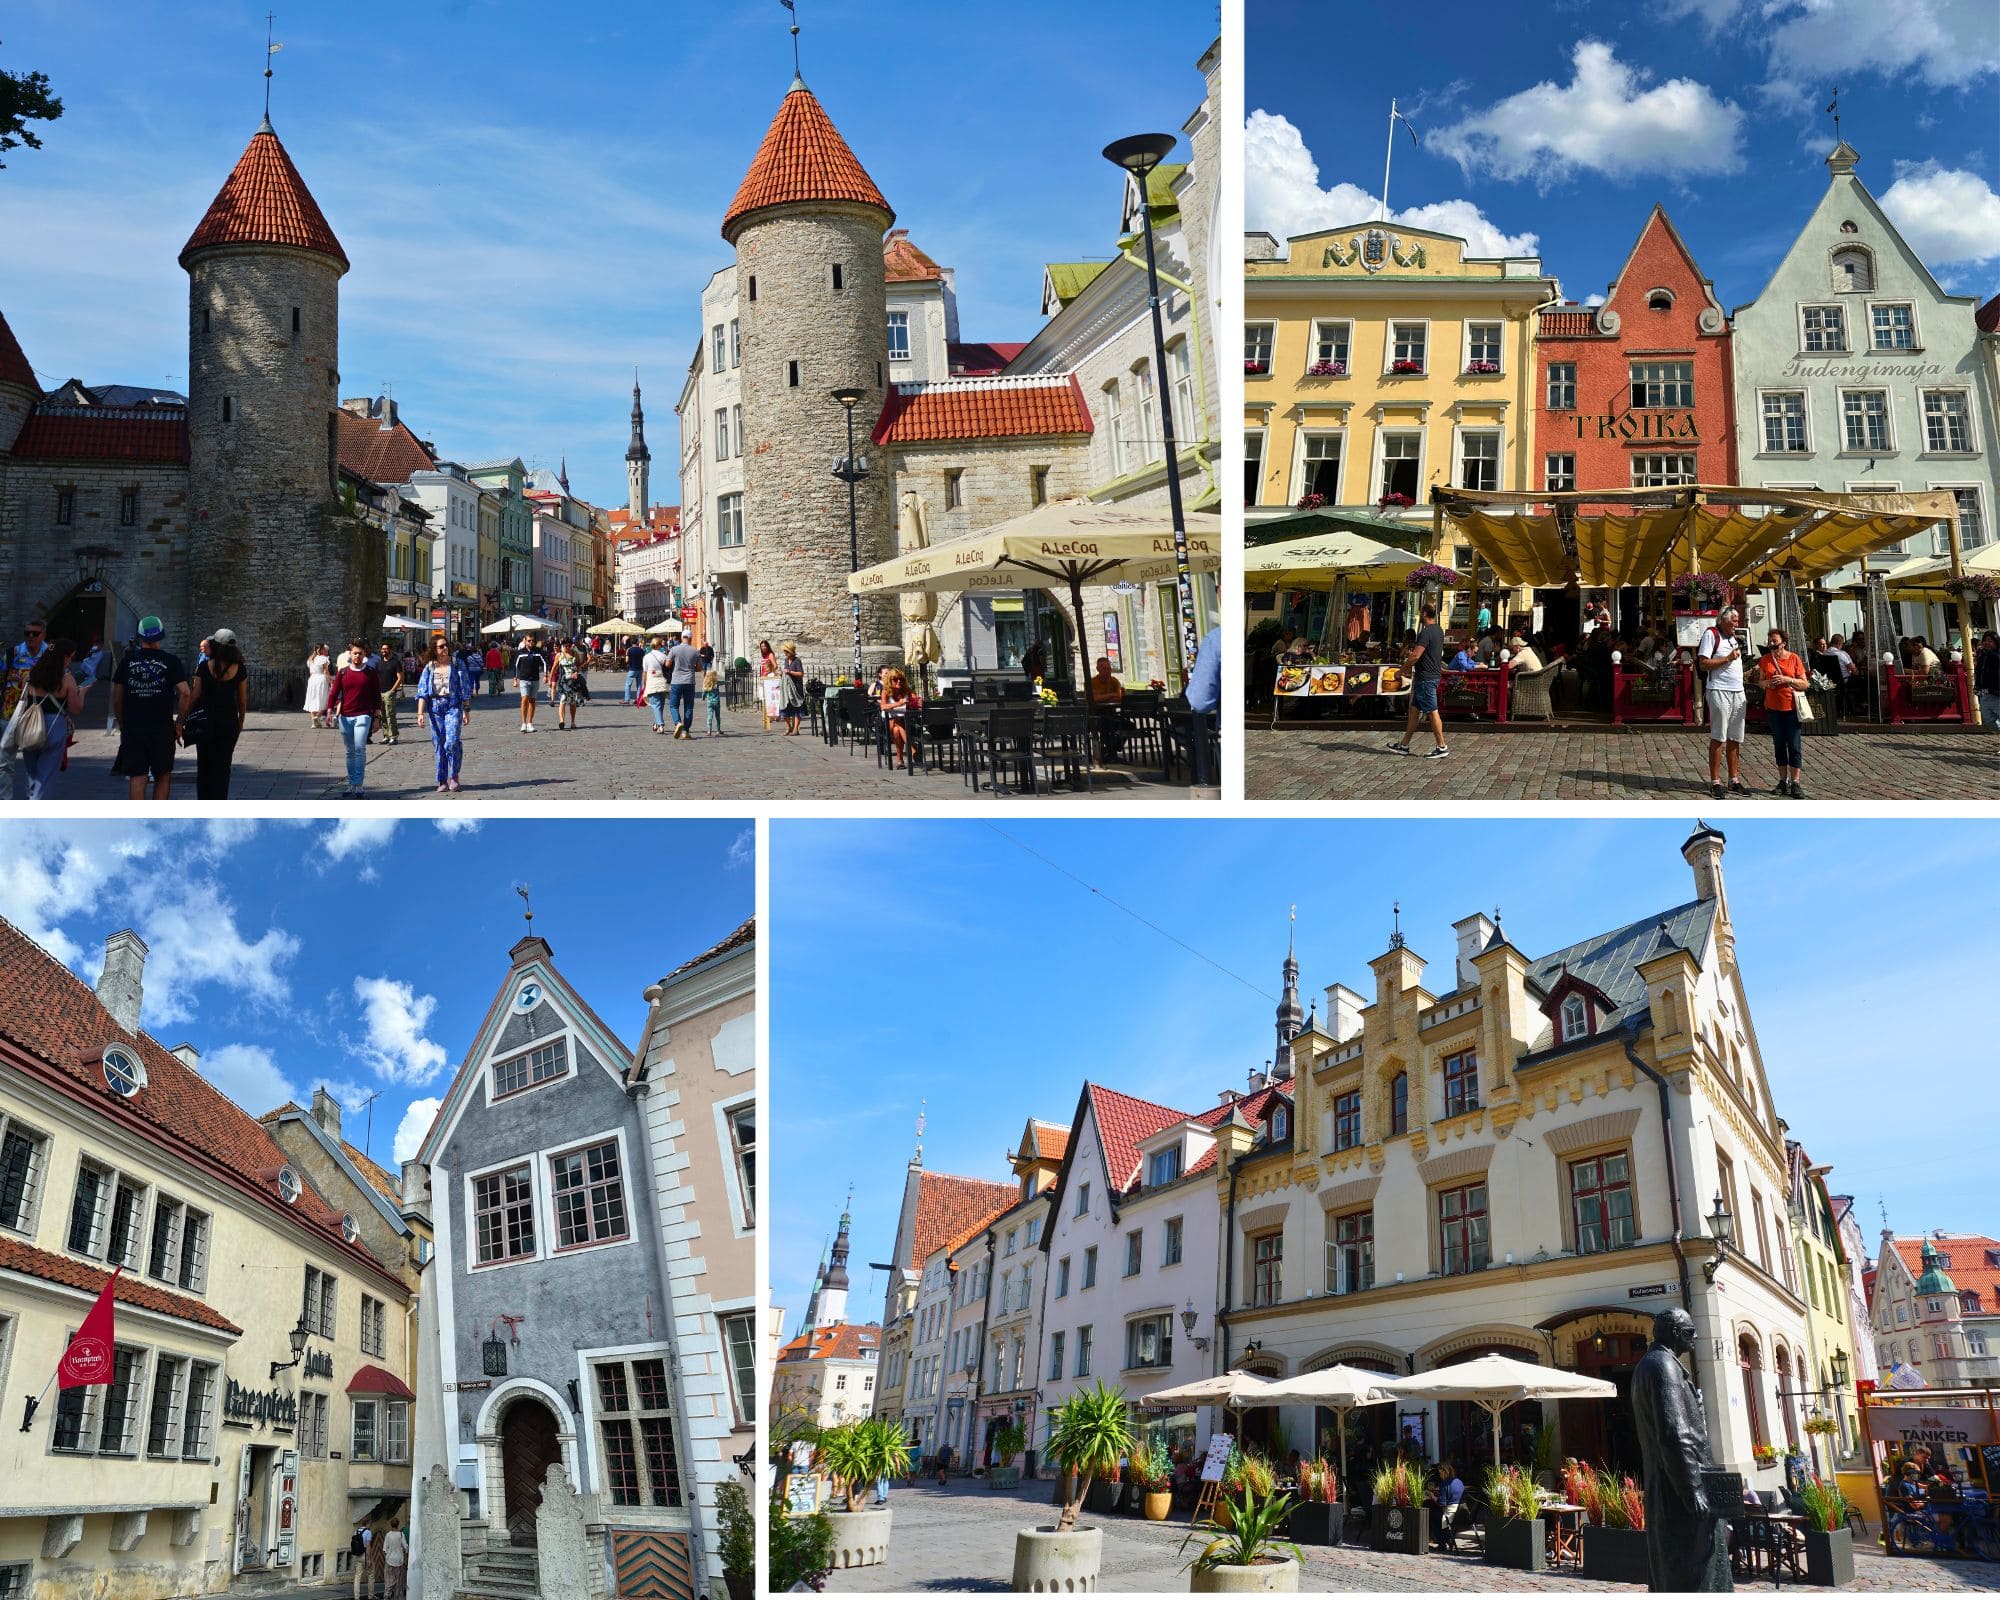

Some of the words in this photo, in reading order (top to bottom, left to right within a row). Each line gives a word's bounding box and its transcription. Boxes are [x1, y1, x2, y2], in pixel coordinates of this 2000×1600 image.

[1781, 359, 1947, 383] Tudengimaja
[1568, 410, 1699, 440] TROIKA
[1041, 541, 1099, 556] A.LeCoq
[1153, 539, 1209, 553] A.Loq
[955, 550, 984, 566] A.LeCoq
[904, 562, 931, 577] A.LeCoq
[1667, 1284, 1677, 1292] 13
[1899, 1429, 1969, 1443] TANKER
